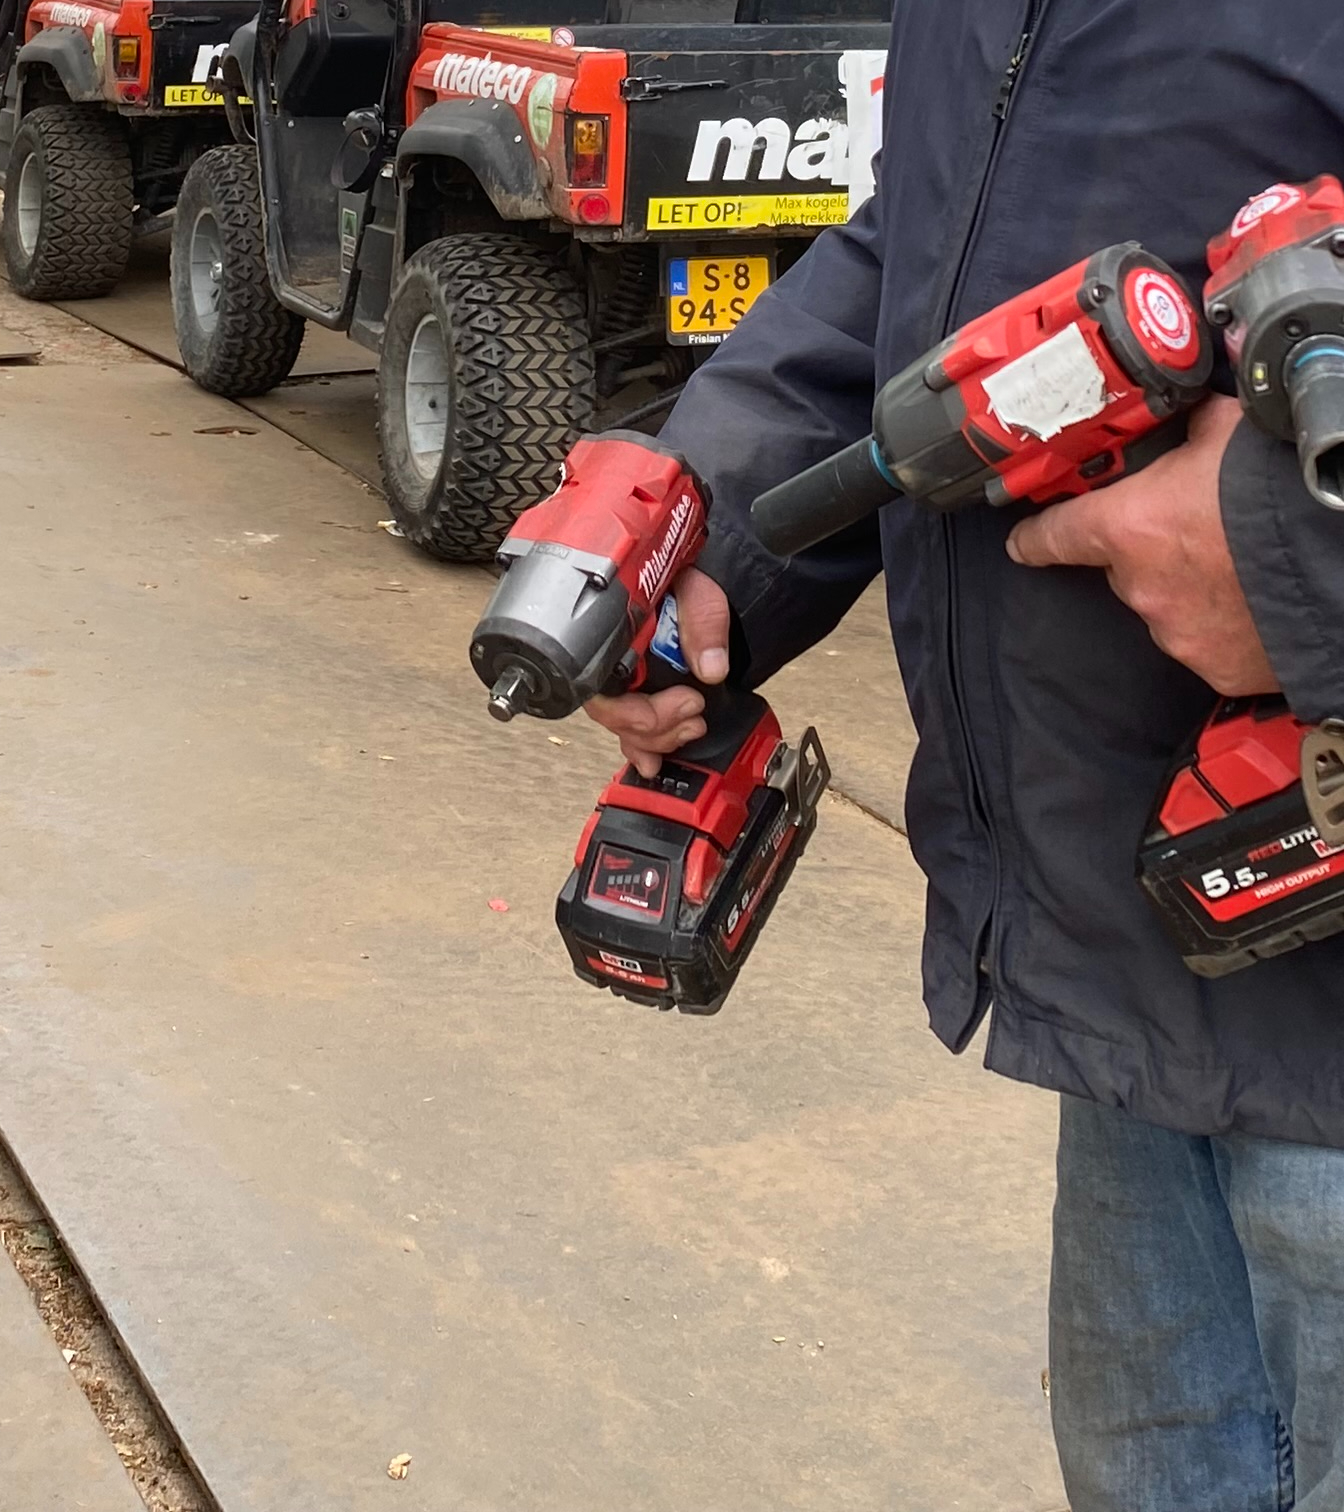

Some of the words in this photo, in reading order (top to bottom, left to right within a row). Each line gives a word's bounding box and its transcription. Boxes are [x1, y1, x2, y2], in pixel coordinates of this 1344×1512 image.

[49, 1, 93, 28] mateco
[432, 52, 533, 105] mateco
[172, 90, 197, 102] LET
[775, 197, 803, 209] Max
[658, 203, 698, 224] LET
[704, 202, 743, 222] OP!
[770, 212, 797, 224] Max
[703, 263, 751, 292] S-8
[673, 282, 686, 291] NL
[688, 334, 721, 344] Frisian
[1254, 883, 1285, 900] HIGH
[1286, 863, 1331, 887] OUTPUT
